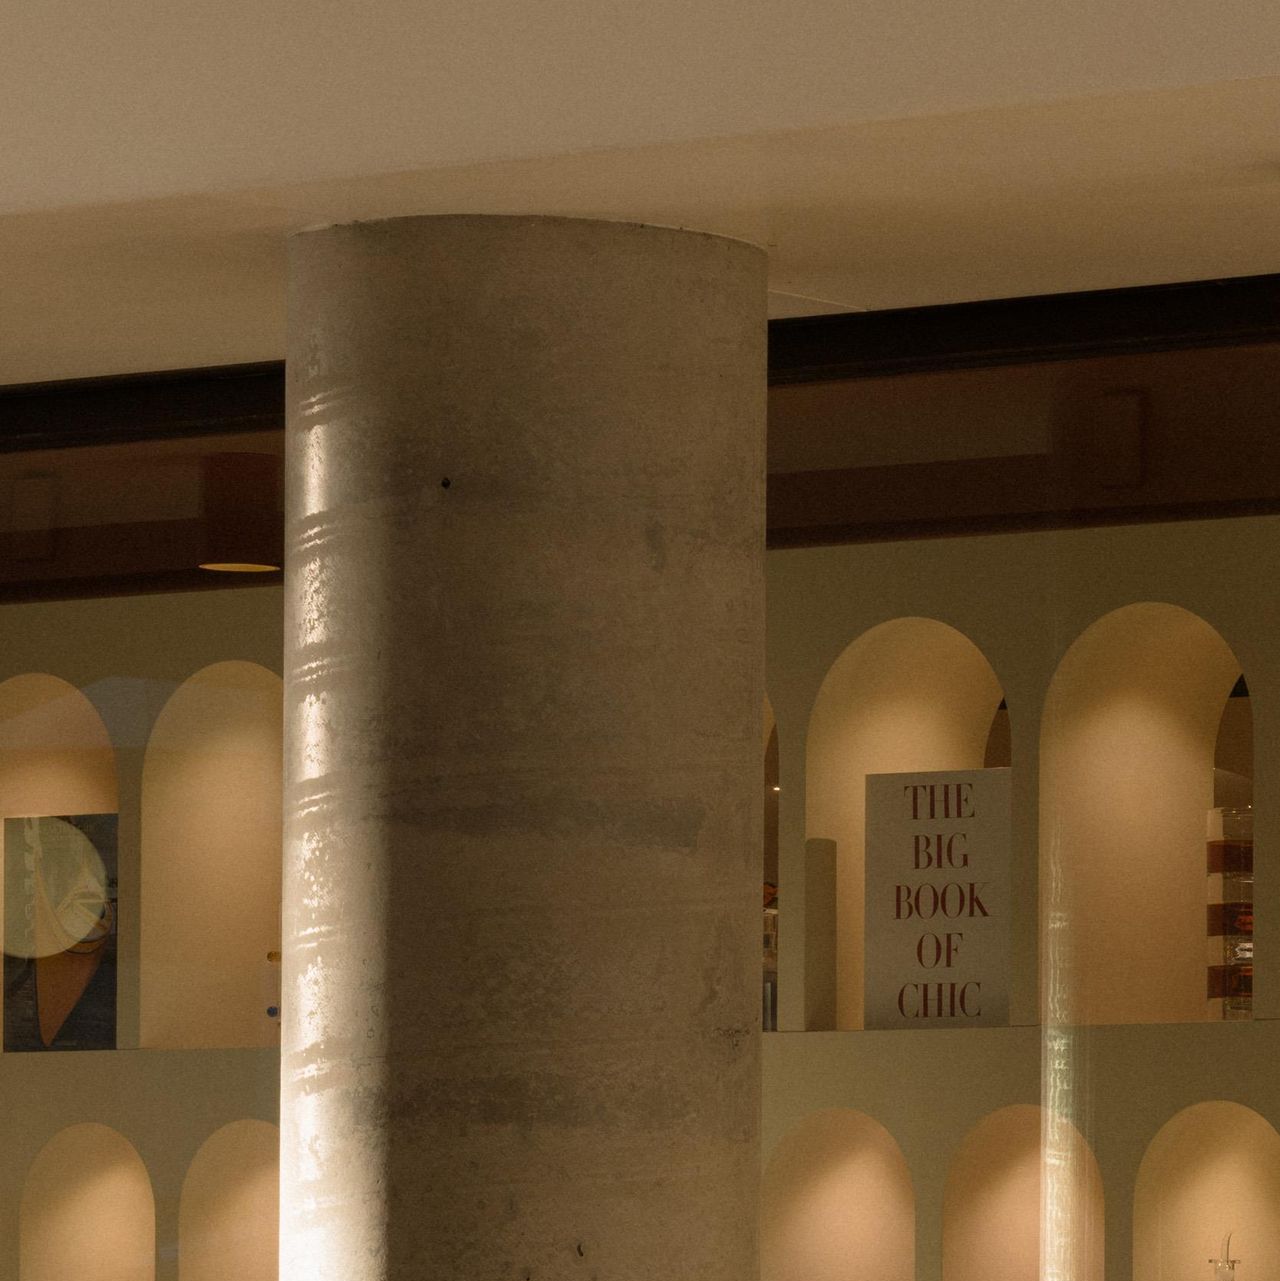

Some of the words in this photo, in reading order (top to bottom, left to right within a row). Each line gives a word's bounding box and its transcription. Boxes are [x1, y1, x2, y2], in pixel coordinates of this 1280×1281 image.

[904, 783, 976, 820] THE
[912, 832, 969, 870] BIG
[892, 881, 993, 920] BOOK
[916, 932, 964, 969] OF
[897, 981, 982, 1018] CHIC
